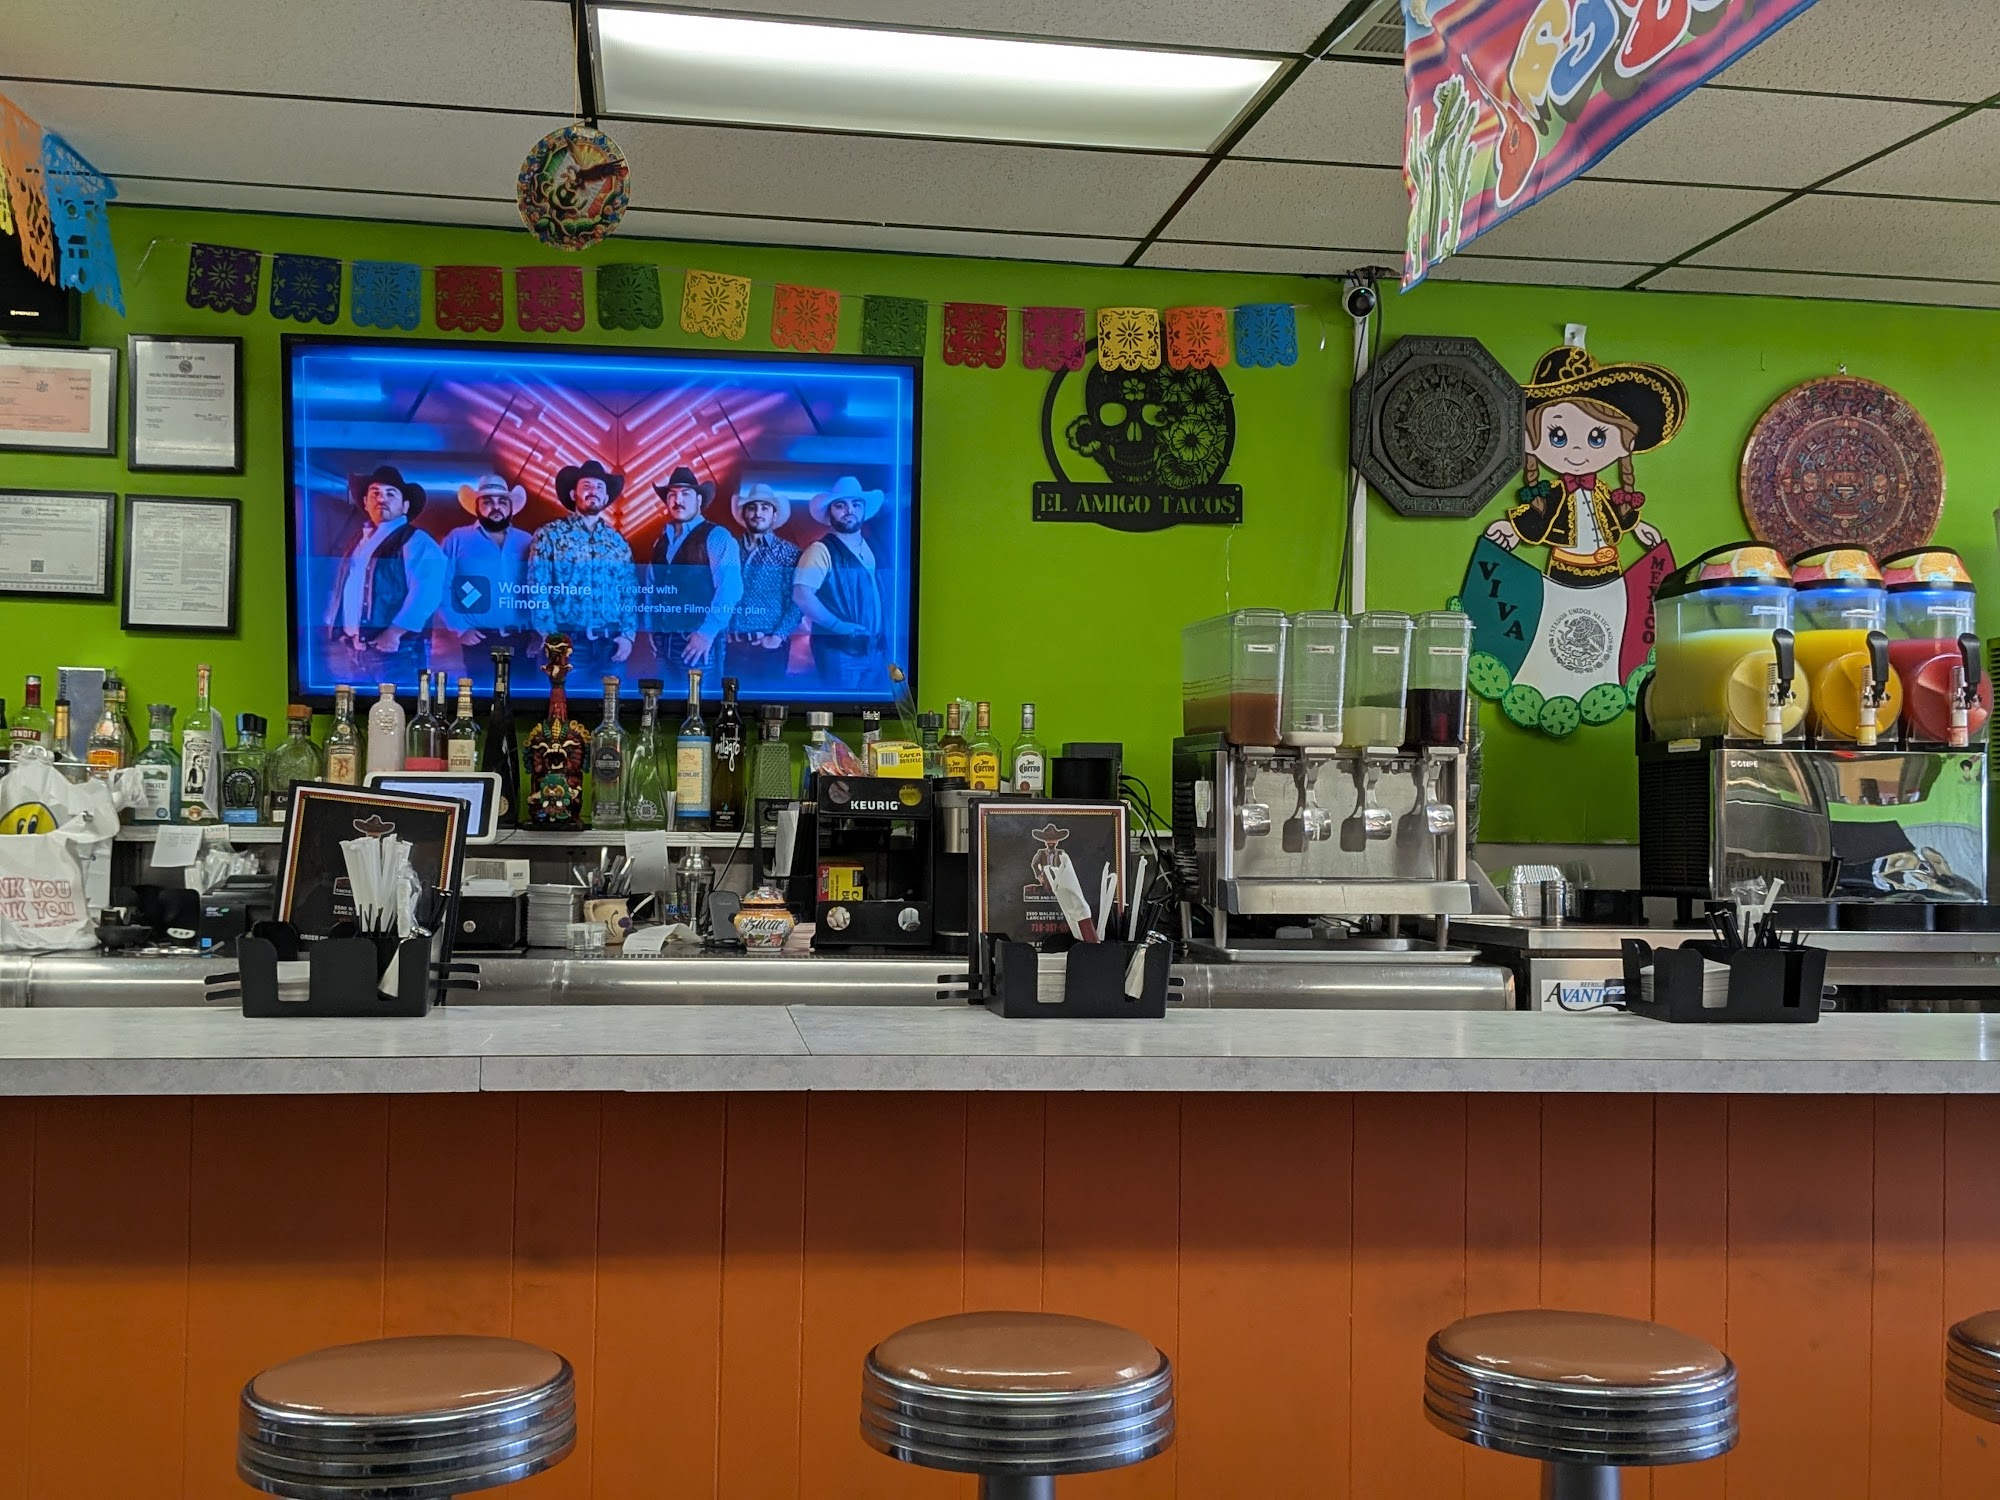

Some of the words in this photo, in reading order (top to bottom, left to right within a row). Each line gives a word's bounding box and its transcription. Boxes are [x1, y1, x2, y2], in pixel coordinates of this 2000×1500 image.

[1040, 494, 1068, 512] EL
[1076, 494, 1150, 513] AMIGO
[1159, 495, 1236, 514] TACOS
[498, 582, 592, 595] Wondershare
[615, 584, 654, 594] Created
[656, 585, 678, 594] with
[499, 597, 550, 609] Filmora
[1478, 560, 1524, 641] VIVA
[615, 603, 682, 613] Wondershare
[684, 604, 720, 614] Filmora
[723, 605, 742, 614] free
[745, 607, 766, 616] plan
[10, 730, 37, 739] RNOFF
[974, 763, 995, 774] Cuervo
[1019, 763, 1041, 774] Cuervo
[851, 800, 898, 810] KEURIG
[29, 879, 71, 899] YOU
[31, 900, 76, 919] YOU
